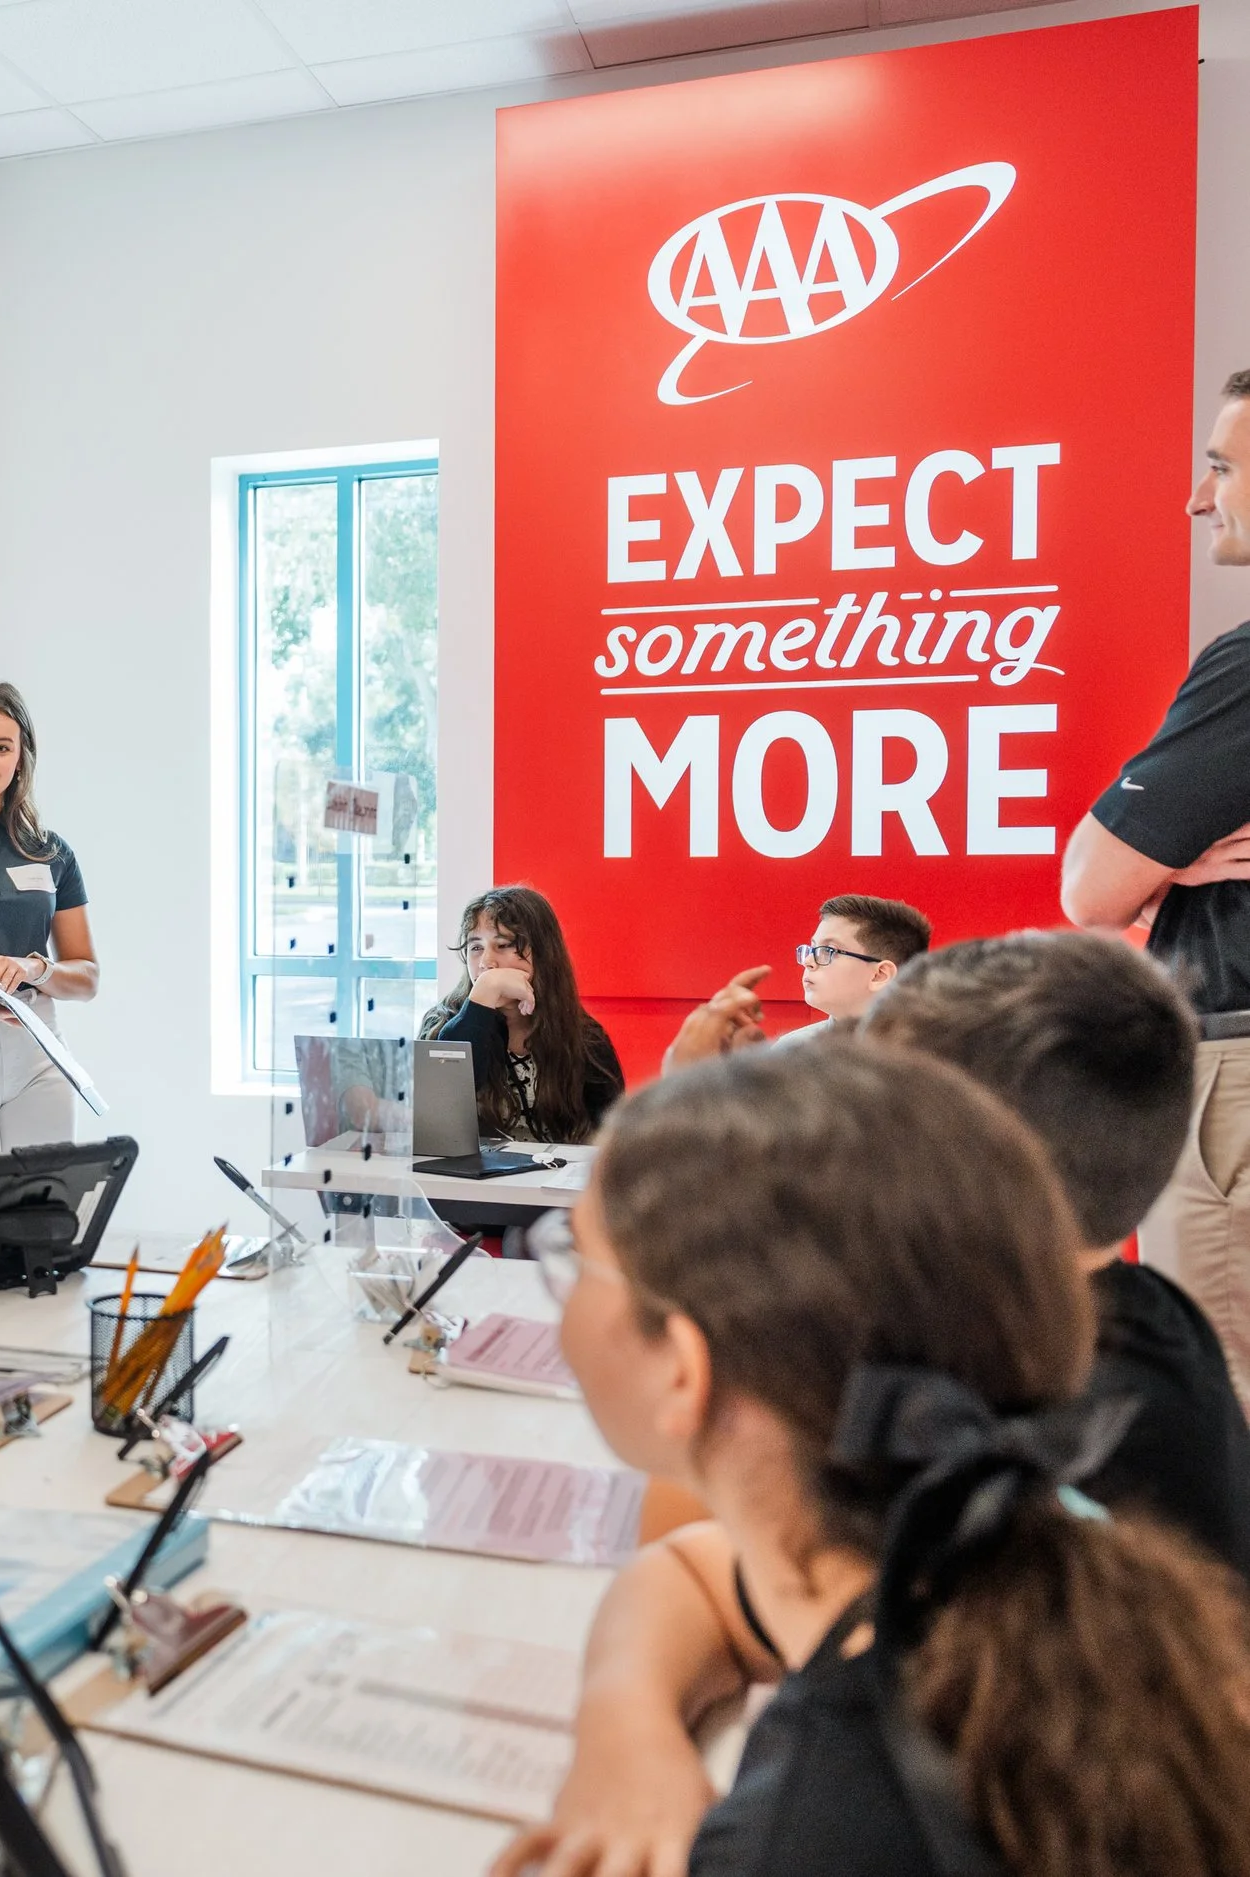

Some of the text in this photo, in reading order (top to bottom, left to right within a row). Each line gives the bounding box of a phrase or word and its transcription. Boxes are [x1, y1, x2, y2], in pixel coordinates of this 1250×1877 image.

[676, 197, 868, 339] AAA
[606, 442, 1061, 584] EXPECT
[594, 588, 1065, 687] something
[603, 703, 1058, 859] MORE
